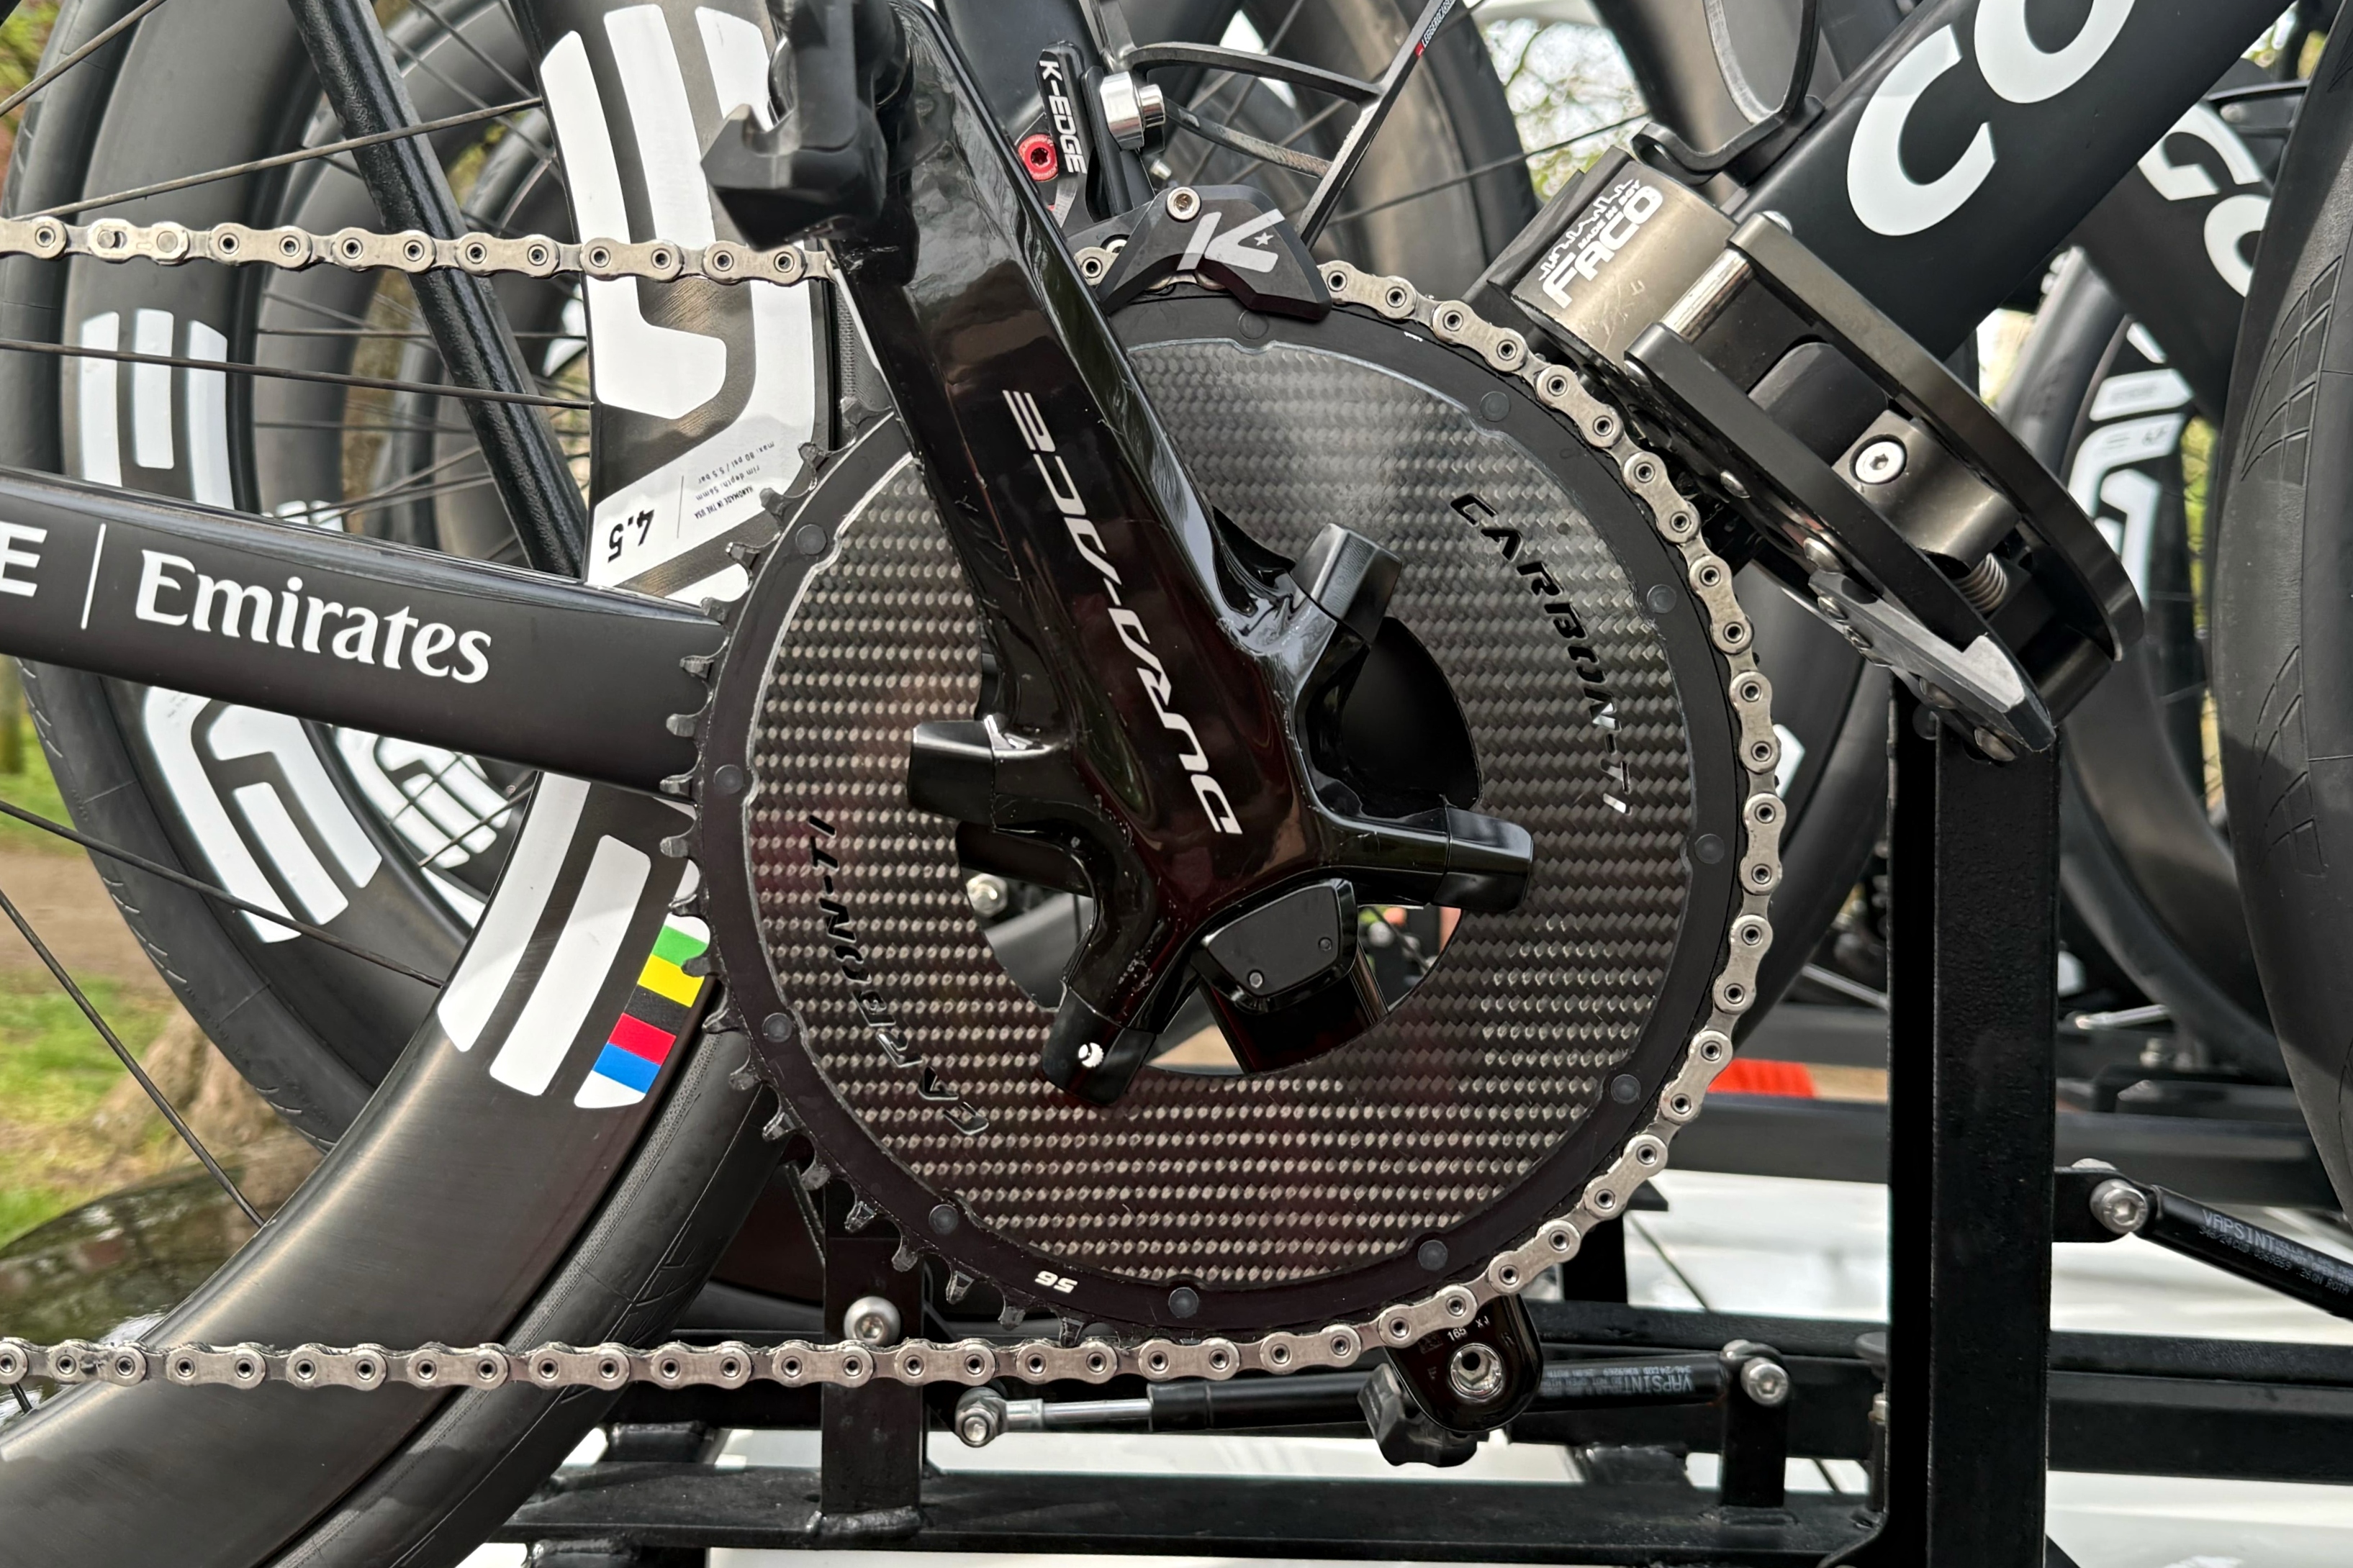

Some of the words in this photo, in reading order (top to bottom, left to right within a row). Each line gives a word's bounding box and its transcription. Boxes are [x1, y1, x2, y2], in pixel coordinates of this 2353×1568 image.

[1039, 60, 1088, 174] K-EDGE
[1577, 219, 1606, 249] MADE
[1604, 206, 1619, 220] IN
[1542, 186, 1663, 309] FACO
[731, 456, 744, 468] psi
[744, 451, 755, 462] 80
[698, 471, 712, 484] bar
[712, 466, 725, 479] 5.5
[746, 465, 760, 476] rim
[695, 487, 720, 501] 56mm
[716, 500, 722, 509] IN
[723, 484, 754, 507] HANDMADE
[694, 507, 707, 520] USA
[706, 503, 717, 515] THE
[608, 508, 655, 563] 4.5
[135, 549, 492, 684] Emirates
[1003, 390, 1243, 835] DURA-ACE
[1450, 493, 1632, 815] CARBON-TI
[2202, 1209, 2276, 1253] VAPSINT
[1034, 1270, 1078, 1294] 56
[1448, 1327, 1468, 1342] 165
[1623, 1374, 1694, 1395] VAPSINT
